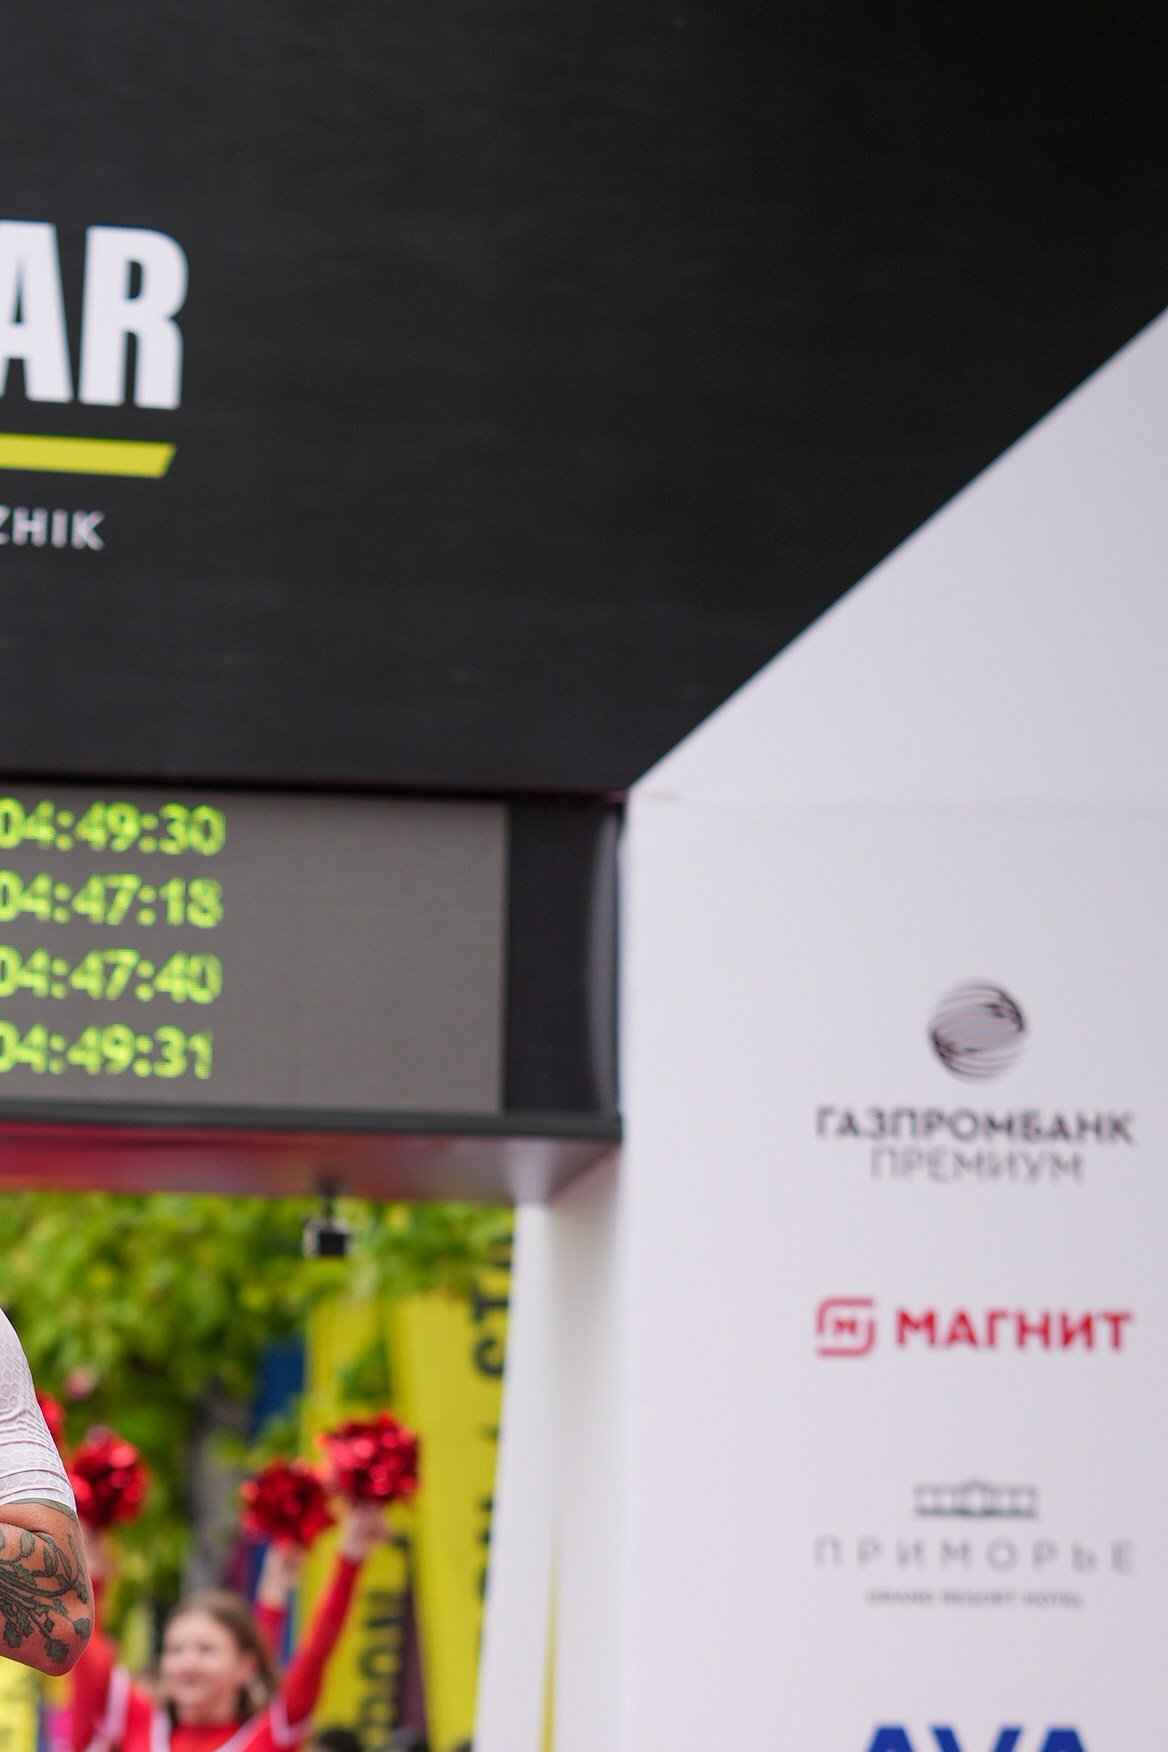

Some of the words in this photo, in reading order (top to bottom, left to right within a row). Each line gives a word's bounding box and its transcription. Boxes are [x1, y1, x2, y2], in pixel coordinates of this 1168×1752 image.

[817, 1107, 1134, 1145] ГАЗПРОМБАНК
[870, 1147, 1084, 1182] ПРЕМИУМ
[896, 1308, 1133, 1351] МАГНИТ
[815, 1535, 1136, 1576] ПРИМОРЬЕ
